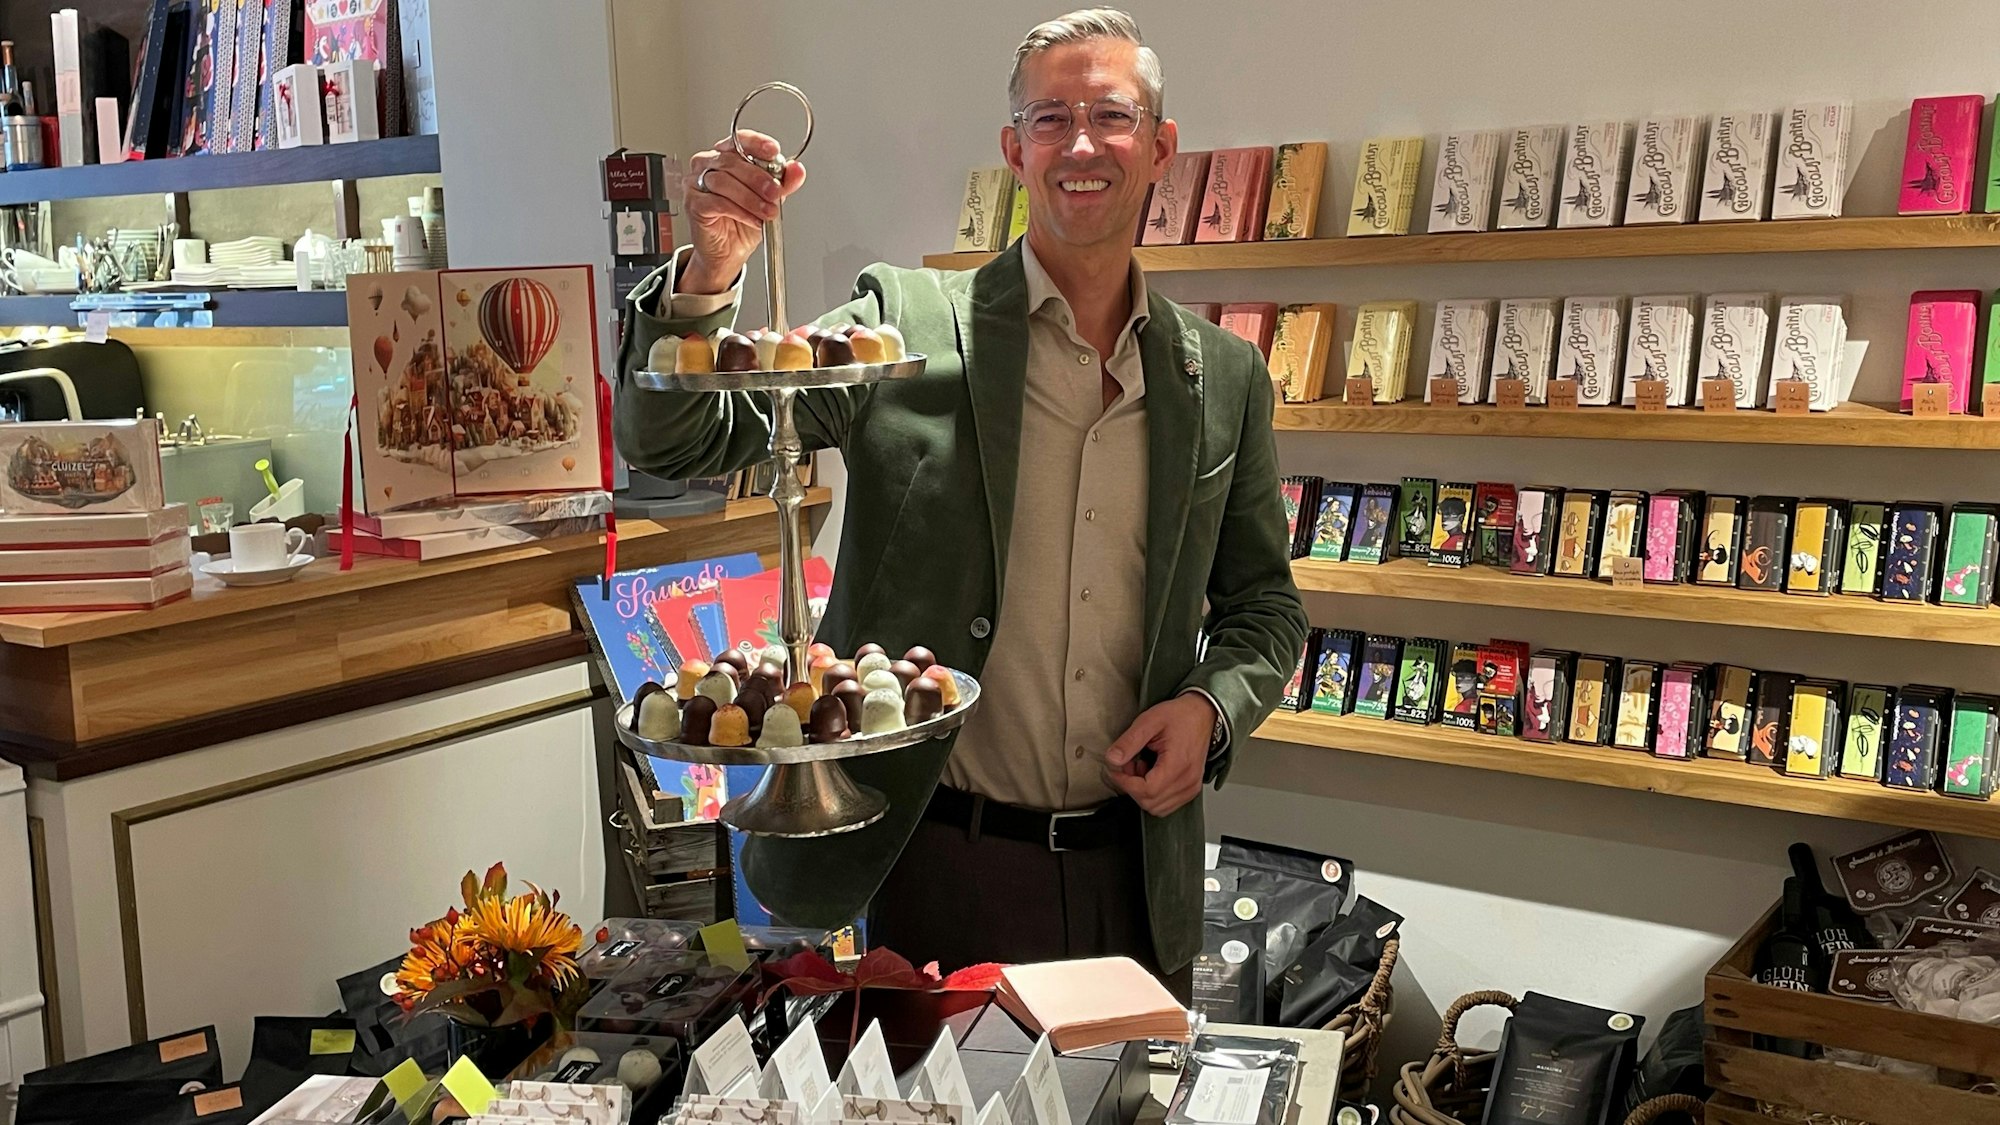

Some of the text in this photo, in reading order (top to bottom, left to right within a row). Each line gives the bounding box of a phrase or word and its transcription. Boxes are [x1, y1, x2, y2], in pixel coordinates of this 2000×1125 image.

[51, 462, 87, 472] CLUIZEL
[1366, 547, 1382, 556] 75%
[1415, 543, 1430, 553] 82%
[1442, 555, 1461, 565] 100%
[1372, 701, 1387, 711] 75%
[1410, 709, 1427, 720] 82%
[1456, 717, 1475, 728] 100%
[1821, 941, 1855, 955] EIN
